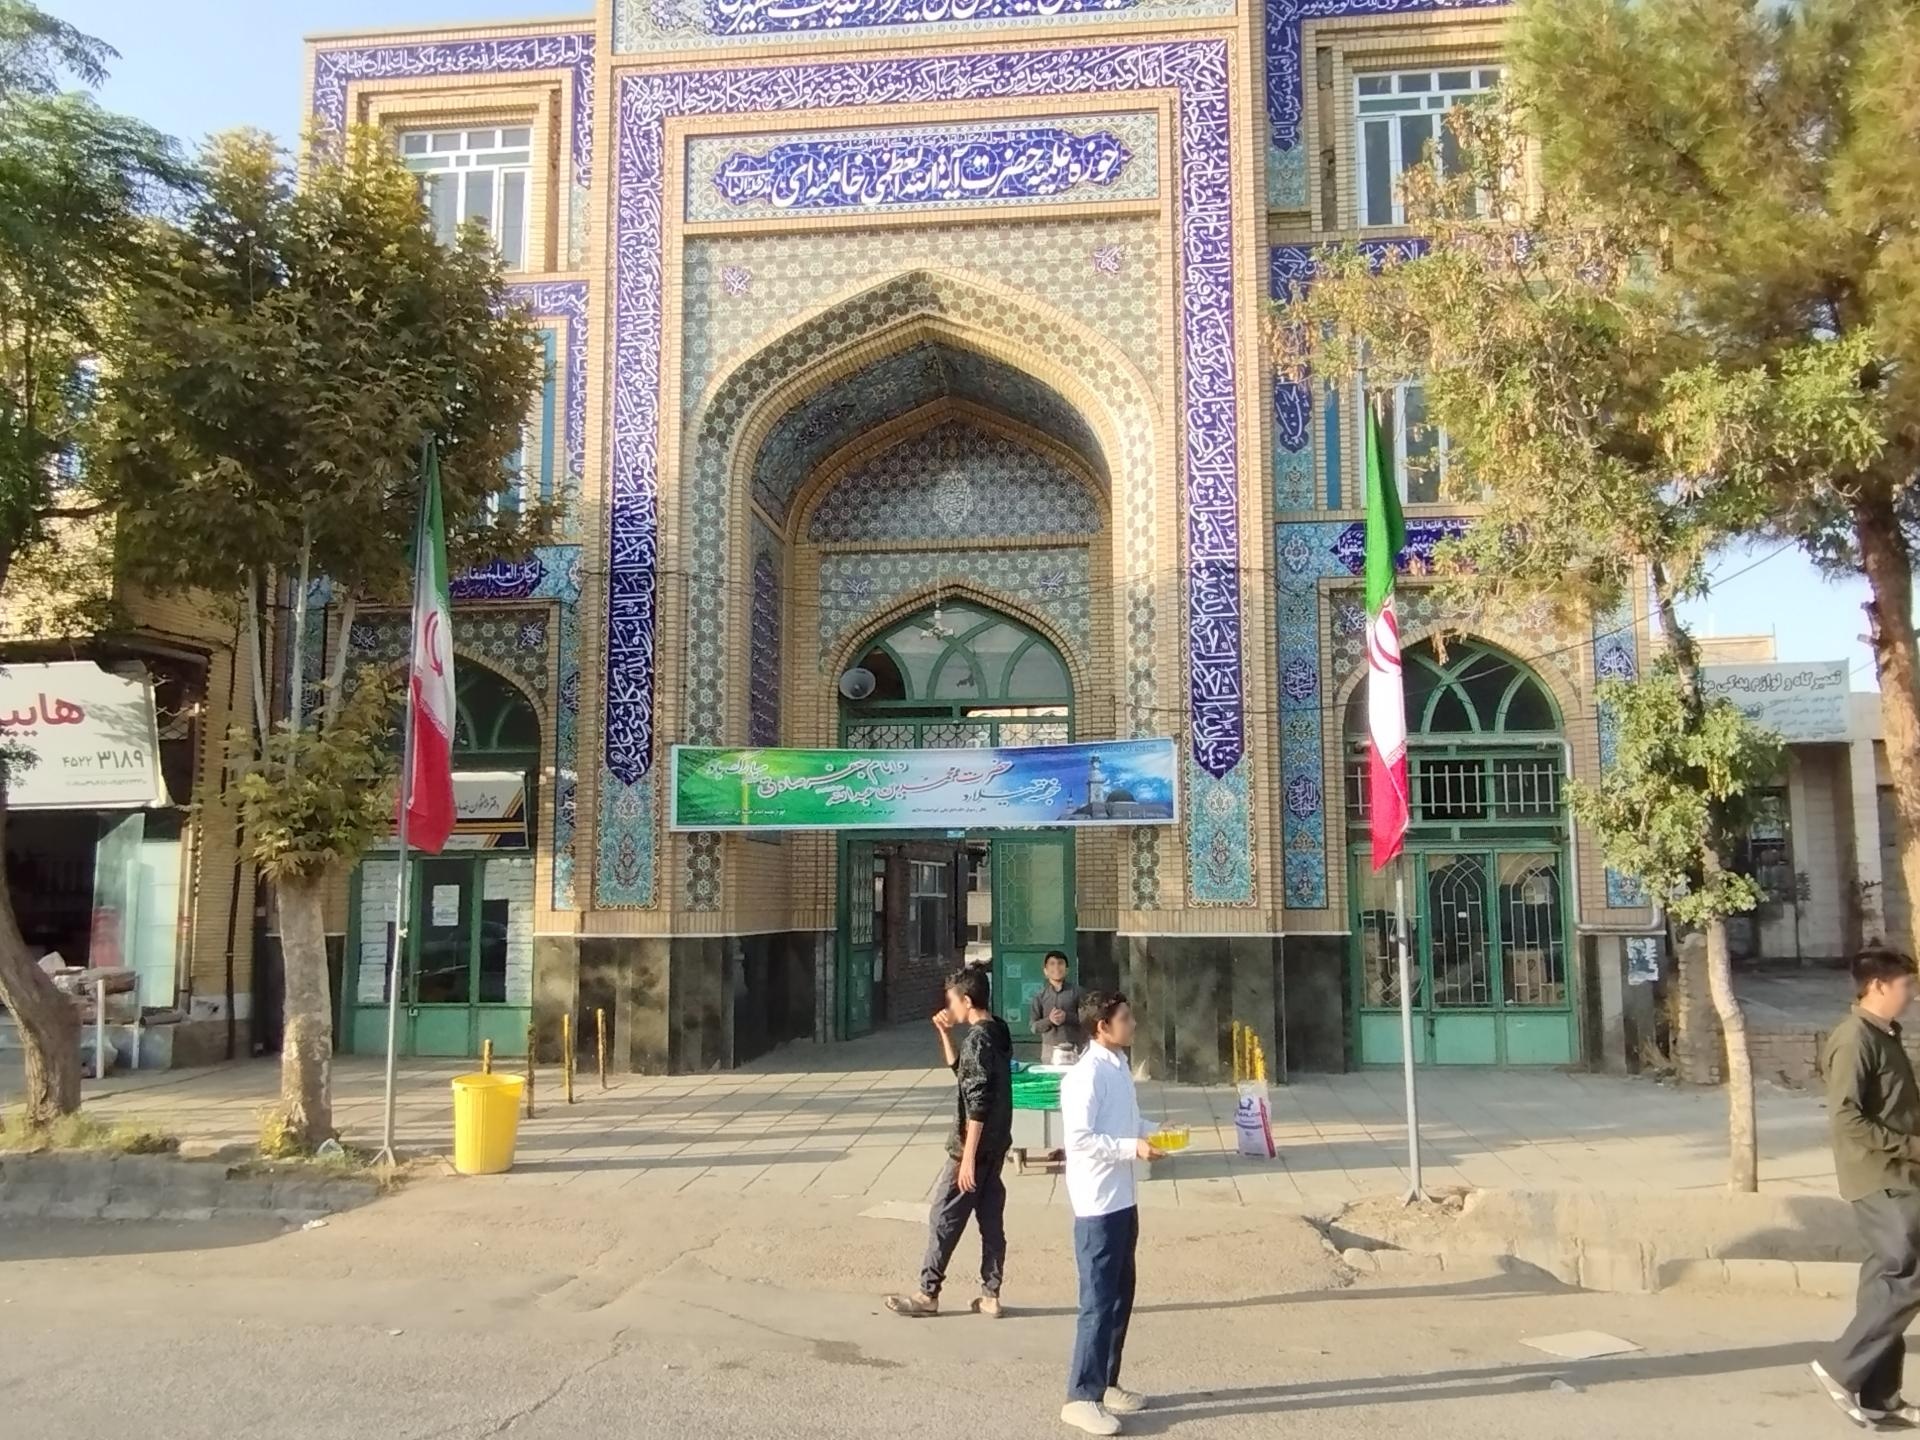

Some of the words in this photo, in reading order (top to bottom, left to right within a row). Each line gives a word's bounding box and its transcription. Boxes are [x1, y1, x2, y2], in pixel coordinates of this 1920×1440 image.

[1270, 121, 1298, 147] النار
[960, 146, 1045, 198] حضرت
[1027, 140, 1073, 194] علمیه
[1068, 141, 1119, 183] حوزه
[1716, 674, 1751, 694] یدکی
[1750, 672, 1783, 693] لوازم
[1783, 676, 1793, 692] و
[62, 756, 93, 768] ۴۵۲۲
[97, 750, 145, 769] ۳۱۸۹
[956, 757, 1016, 786] حضرت
[756, 774, 808, 799] صادق
[803, 758, 872, 790] جعفر
[900, 766, 961, 794] محمد
